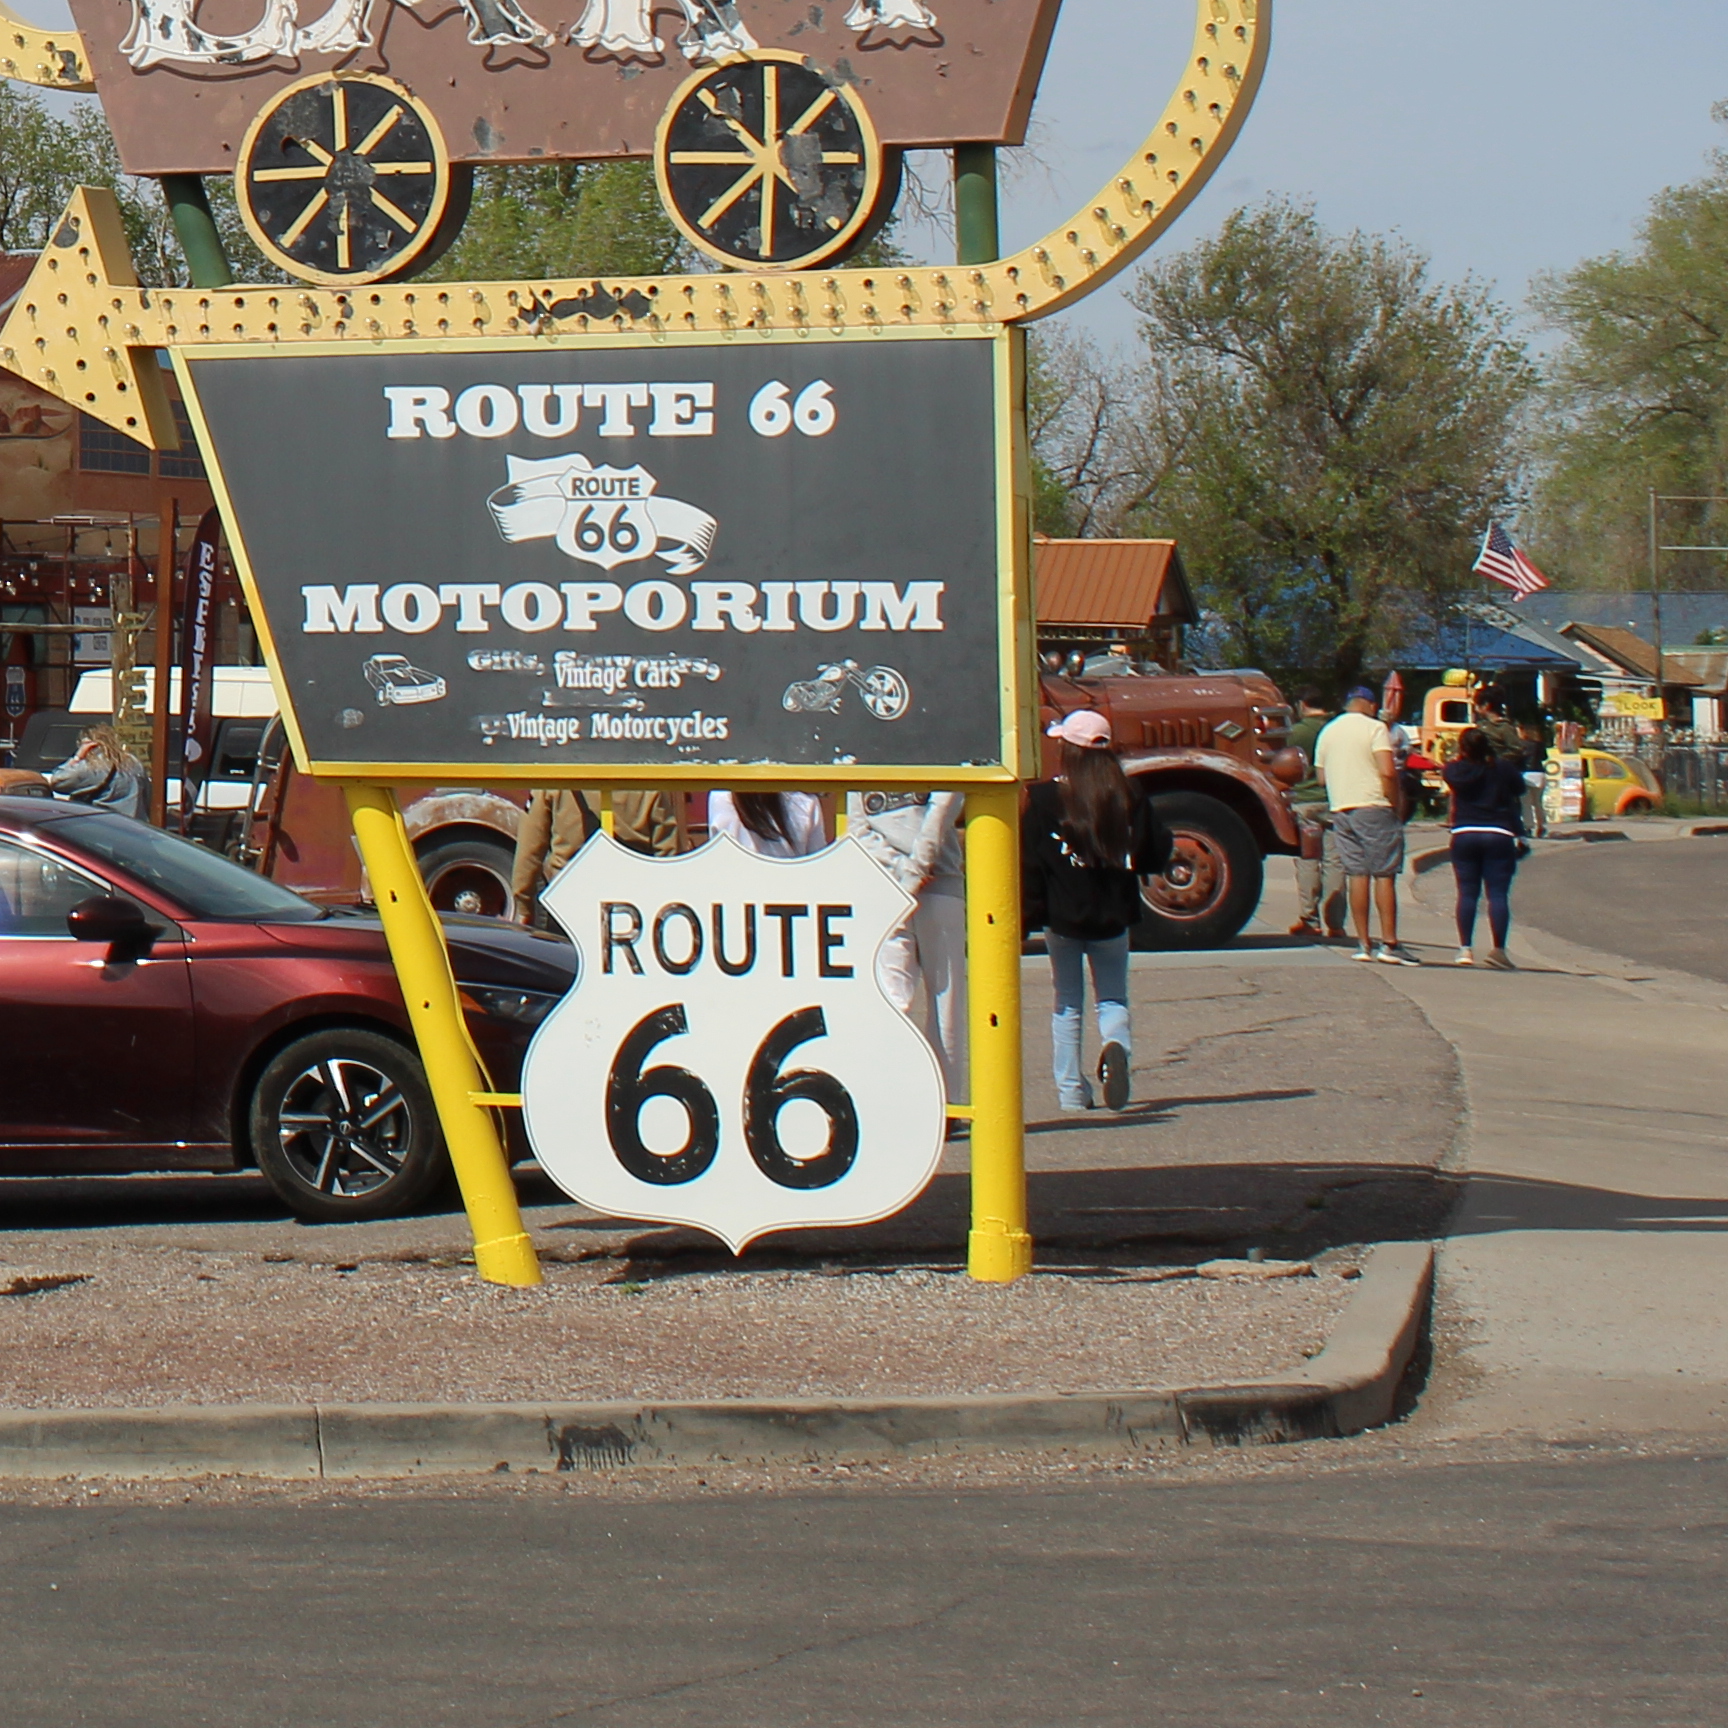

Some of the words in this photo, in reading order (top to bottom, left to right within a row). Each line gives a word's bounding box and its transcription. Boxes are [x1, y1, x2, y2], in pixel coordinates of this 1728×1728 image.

[383, 381, 714, 440] ROUTE
[748, 378, 837, 437] 66
[571, 477, 640, 496] ROUTE
[574, 503, 641, 553] 66
[301, 580, 945, 634] MOTOPORIUM
[555, 663, 628, 694] Vintage
[633, 660, 682, 688] Cars
[507, 713, 581, 746] Vintage
[590, 710, 730, 744] Motorcycles
[1624, 701, 1656, 710] LOOK
[598, 902, 855, 978] ROUTE
[606, 1003, 859, 1189] 66
